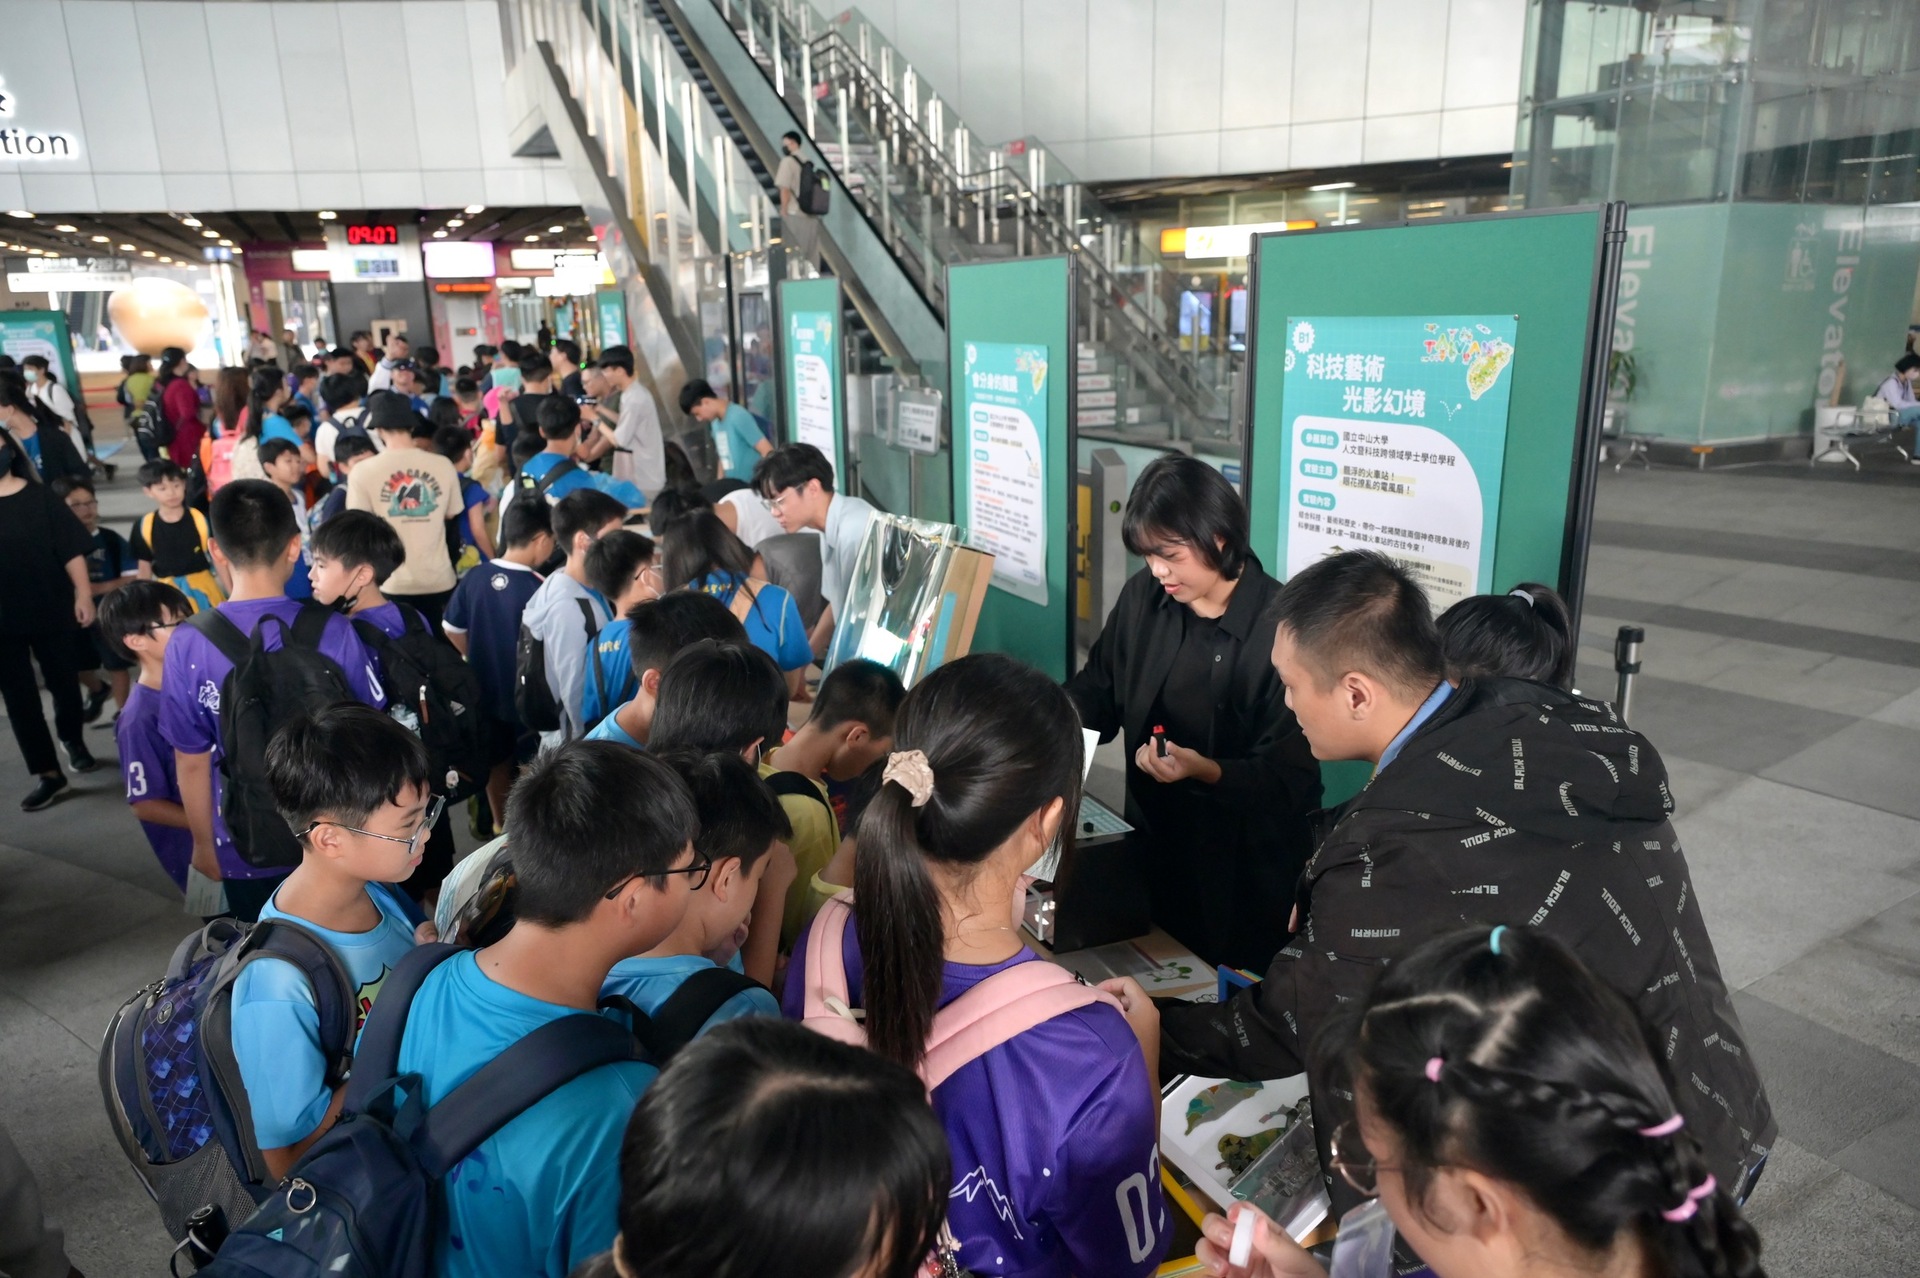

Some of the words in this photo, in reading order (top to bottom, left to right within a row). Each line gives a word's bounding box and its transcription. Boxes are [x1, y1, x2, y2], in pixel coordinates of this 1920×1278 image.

[0, 129, 69, 155] tion
[1815, 228, 1864, 405] Elevato
[1298, 331, 1310, 345] B1
[1306, 353, 1385, 383] 科技藝術
[1342, 385, 1426, 418] 光影幻境
[1343, 431, 1389, 445] 國立中山大學
[1304, 462, 1333, 476] 實驗主題
[1342, 445, 1456, 467] 人文暨科技跨領域學士學位學程
[1302, 493, 1331, 507] 實驗內容
[1571, 724, 1600, 732] SOUL
[1436, 751, 1482, 777] ONIARAI
[1513, 759, 1525, 790] BLACK
[127, 761, 147, 798] 3
[1559, 781, 1579, 817] ONIARAI
[1475, 806, 1506, 827] SOUL
[1460, 832, 1491, 848] SOUL
[1544, 869, 1572, 908] BLACK
[1600, 887, 1622, 916] SOUL
[1351, 928, 1401, 938] ONIARAI
[1618, 913, 1642, 947] BLACK
